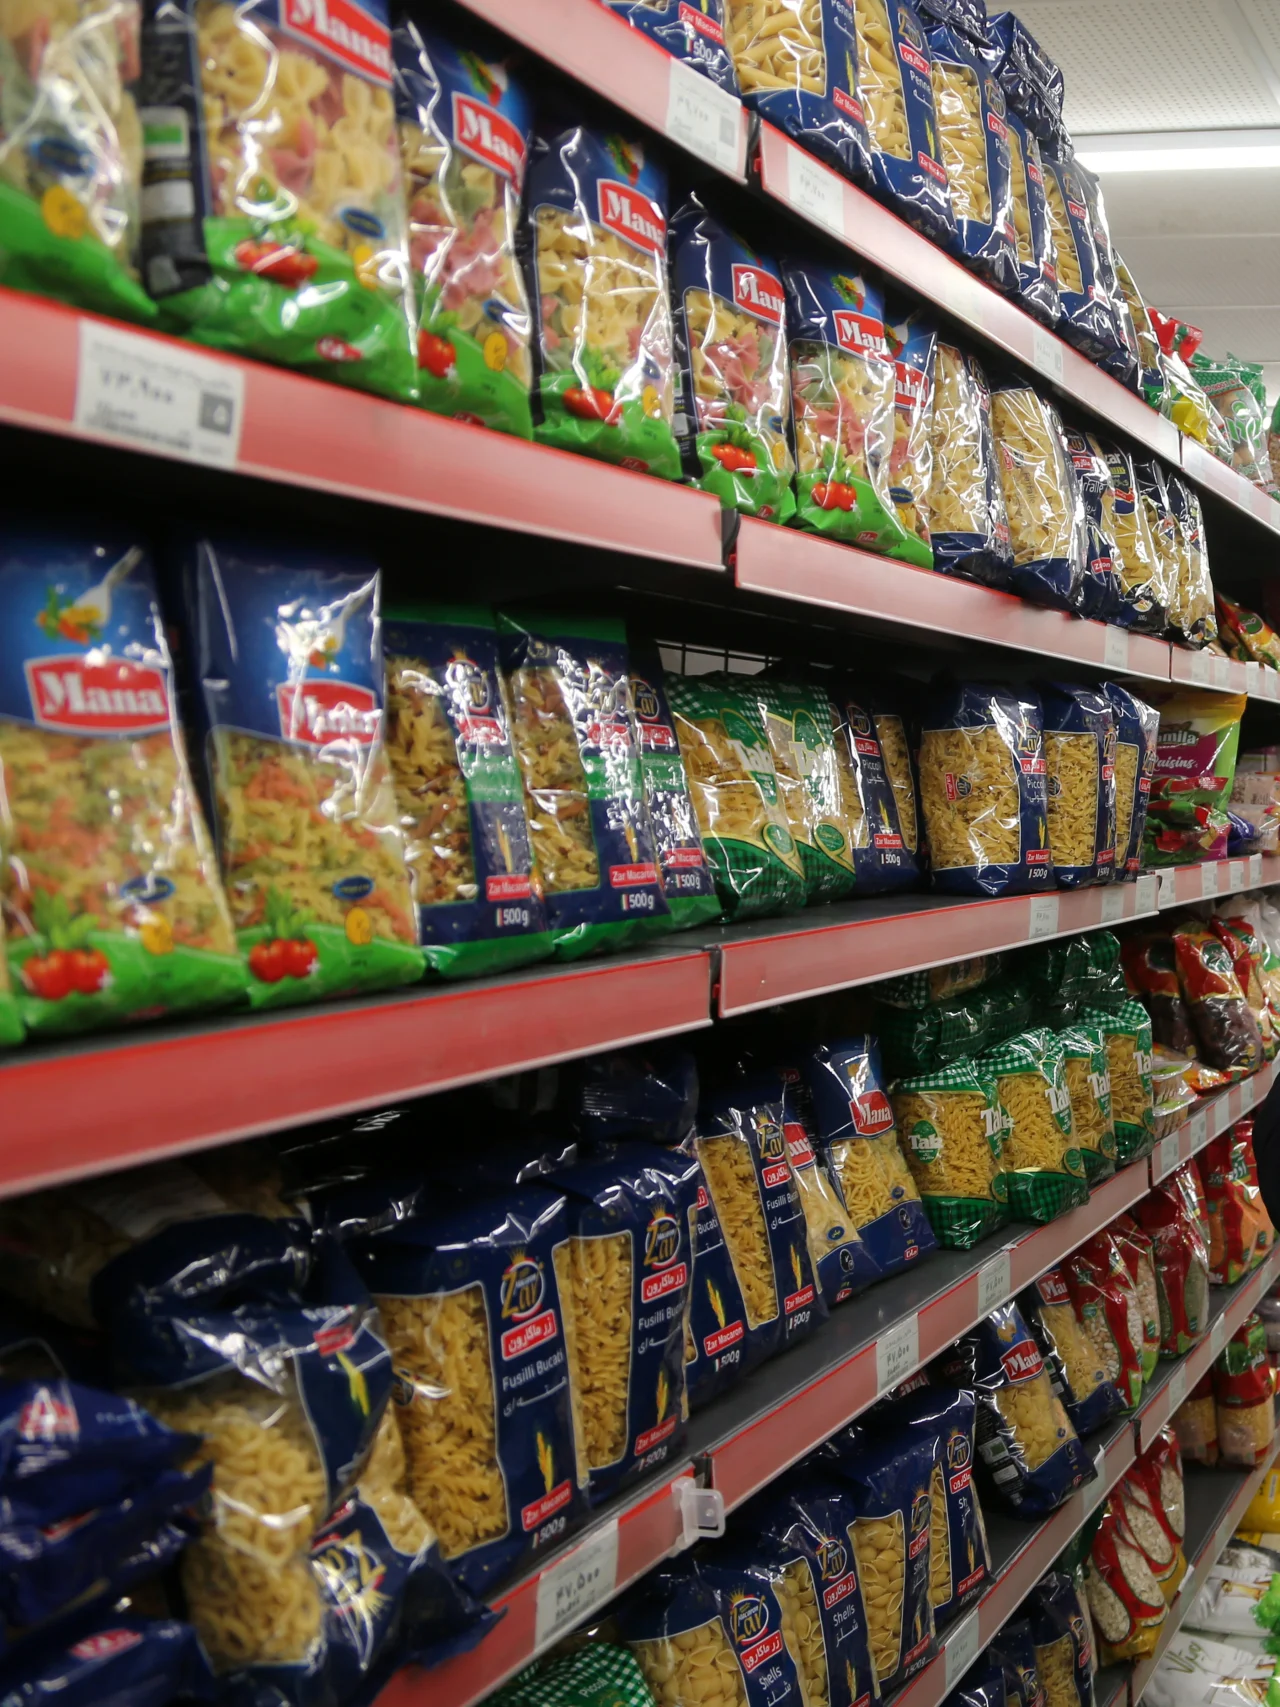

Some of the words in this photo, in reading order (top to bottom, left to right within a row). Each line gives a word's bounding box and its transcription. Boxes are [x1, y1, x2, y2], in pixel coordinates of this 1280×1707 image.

[737, 273, 783, 311] Man
[839, 318, 884, 350] Man
[894, 379, 929, 399] ana
[40, 670, 167, 715] Mana
[1158, 732, 1199, 745] amila
[885, 853, 901, 866] 500g
[613, 870, 625, 882] Zar
[682, 874, 700, 890] 500g
[1032, 868, 1048, 880] 500g
[629, 893, 654, 910] 500g
[503, 908, 529, 926] 500g
[858, 1103, 891, 1127] Mana
[787, 1136, 810, 1157] ana
[908, 1134, 943, 1150] Tak
[766, 1196, 786, 1211] Fusilli
[697, 1218, 718, 1236] Bucati
[644, 1225, 677, 1266] Zar
[501, 1270, 539, 1318] Zar
[786, 1300, 796, 1310] Zar
[638, 1310, 665, 1330] Fusilli
[793, 1310, 811, 1327] 500g
[508, 1322, 546, 1352] ماکارون
[706, 1337, 718, 1351] Zar
[718, 1326, 743, 1344] Macaron
[720, 1350, 740, 1368] 500g
[1006, 1352, 1041, 1377] Mana
[502, 1363, 534, 1389] Fusilli
[536, 1352, 564, 1376] Bucati
[525, 1508, 539, 1525] Zar
[539, 1516, 566, 1542] 500g
[731, 1596, 766, 1643] Zar
[833, 1604, 855, 1627] Shells
[744, 1641, 771, 1670] ماکارون
[759, 1665, 783, 1691] Shells
